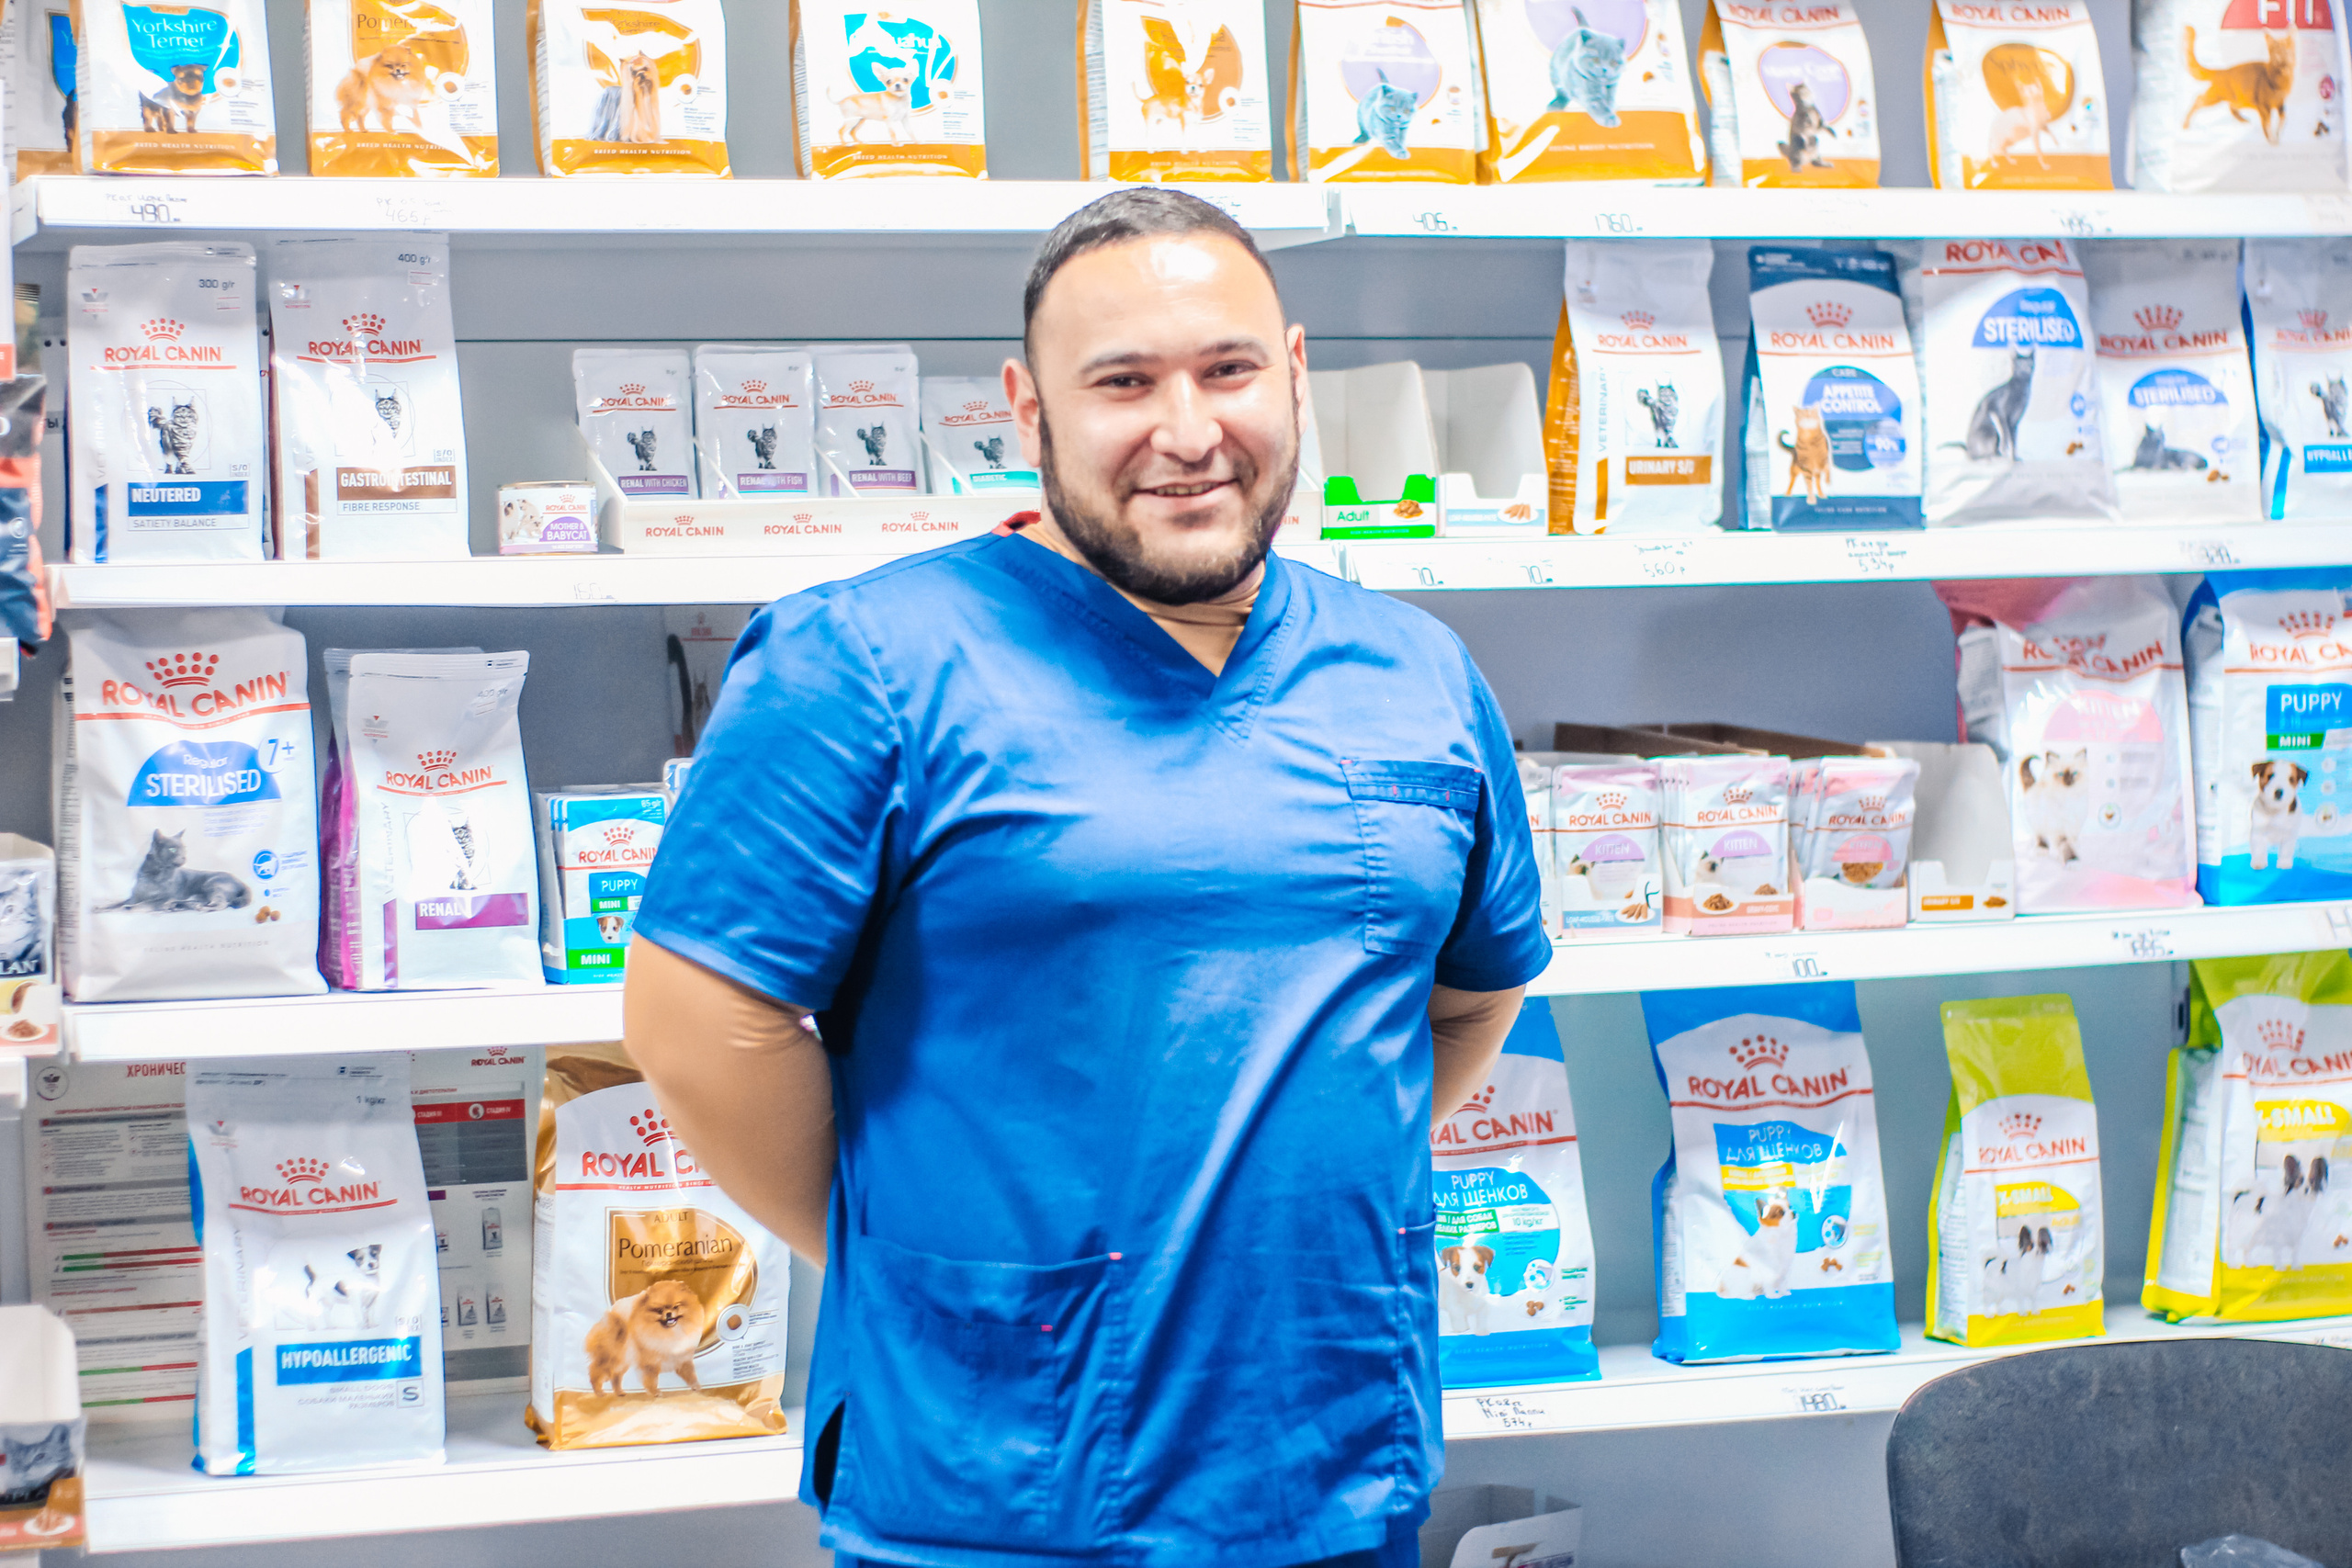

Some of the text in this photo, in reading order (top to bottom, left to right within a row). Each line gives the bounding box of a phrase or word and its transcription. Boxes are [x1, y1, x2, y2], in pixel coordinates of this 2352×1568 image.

[2009, 6, 2072, 22] CANIN
[130, 17, 219, 35] Yorkshire
[130, 203, 171, 223] 490
[1412, 212, 1449, 231] 406
[1594, 212, 1634, 232] 1760
[398, 254, 417, 264] 400
[1944, 240, 2015, 264] ROYA
[198, 279, 219, 288] 300
[1983, 316, 2075, 343] STERILISED
[2313, 326, 2352, 344] CANI
[367, 339, 423, 355] CANIN
[1598, 333, 1688, 348] ROYAL CANIN
[1770, 333, 1894, 349] ROYAL CANIN
[2164, 330, 2228, 349] CANIN
[105, 345, 223, 363] ROYAL CANIN
[756, 393, 792, 404] CANIN
[831, 393, 898, 404] ROYAL CANIN
[2133, 382, 2216, 406] STERILISED
[944, 413, 977, 423] ROYAL
[1628, 460, 1676, 475] URINARY
[620, 478, 644, 489] RENAL
[645, 479, 661, 488] WITH
[740, 476, 764, 486] RENAL
[786, 475, 803, 485] FISH
[851, 472, 912, 482] RENAL WITH BEEF
[131, 487, 202, 503] NEUTERED
[343, 501, 421, 513] FIBRE RESPONSE
[133, 517, 217, 528] SATIETY BALANCE
[1337, 510, 1370, 522] Adult
[549, 523, 577, 532] MOTHER
[646, 525, 724, 537] ROYAL CANIN
[763, 523, 842, 535] ROYAL CANIN
[882, 521, 959, 532] ROYAL CANIN
[547, 530, 587, 541] BABYCAT
[2093, 642, 2164, 674] CANIN
[101, 671, 288, 718] ROYAL CANIN
[2280, 692, 2343, 714] PUPPY
[2279, 735, 2312, 747] MINI
[183, 753, 229, 771] Regular
[145, 770, 262, 798] STERILISED
[386, 765, 492, 790] ROYAL CANIN
[1569, 812, 1652, 827] ROYAL CANIN
[1697, 806, 1778, 823] ROYAL CANIN
[1828, 814, 1868, 826] ROYAL
[1595, 843, 1630, 855] KITTEN
[1724, 839, 1758, 852] KITTEN
[579, 850, 619, 863] ROYAL
[601, 879, 639, 892] PUPPY
[419, 902, 461, 918] RENAL
[599, 899, 620, 909] MINI
[581, 953, 611, 965] MINI
[470, 1056, 525, 1066] ROYAL CANIN
[2243, 1049, 2352, 1078] OYAL CANI
[1688, 1067, 1849, 1100] ROYAL CANIN
[1472, 1111, 1555, 1140] CANIN
[2026, 1135, 2086, 1159] CANIN
[582, 1151, 665, 1179] ROYAL
[1452, 1170, 1495, 1190] PUPPY
[239, 1181, 379, 1207] ROYAL CANIN
[1463, 1183, 1529, 1208] ЩЕНКОВ
[653, 1211, 689, 1224] ADULT
[618, 1234, 733, 1259] Pomeranian
[280, 1343, 413, 1370] HYPOALLERGENIC
[401, 1385, 420, 1402] S
